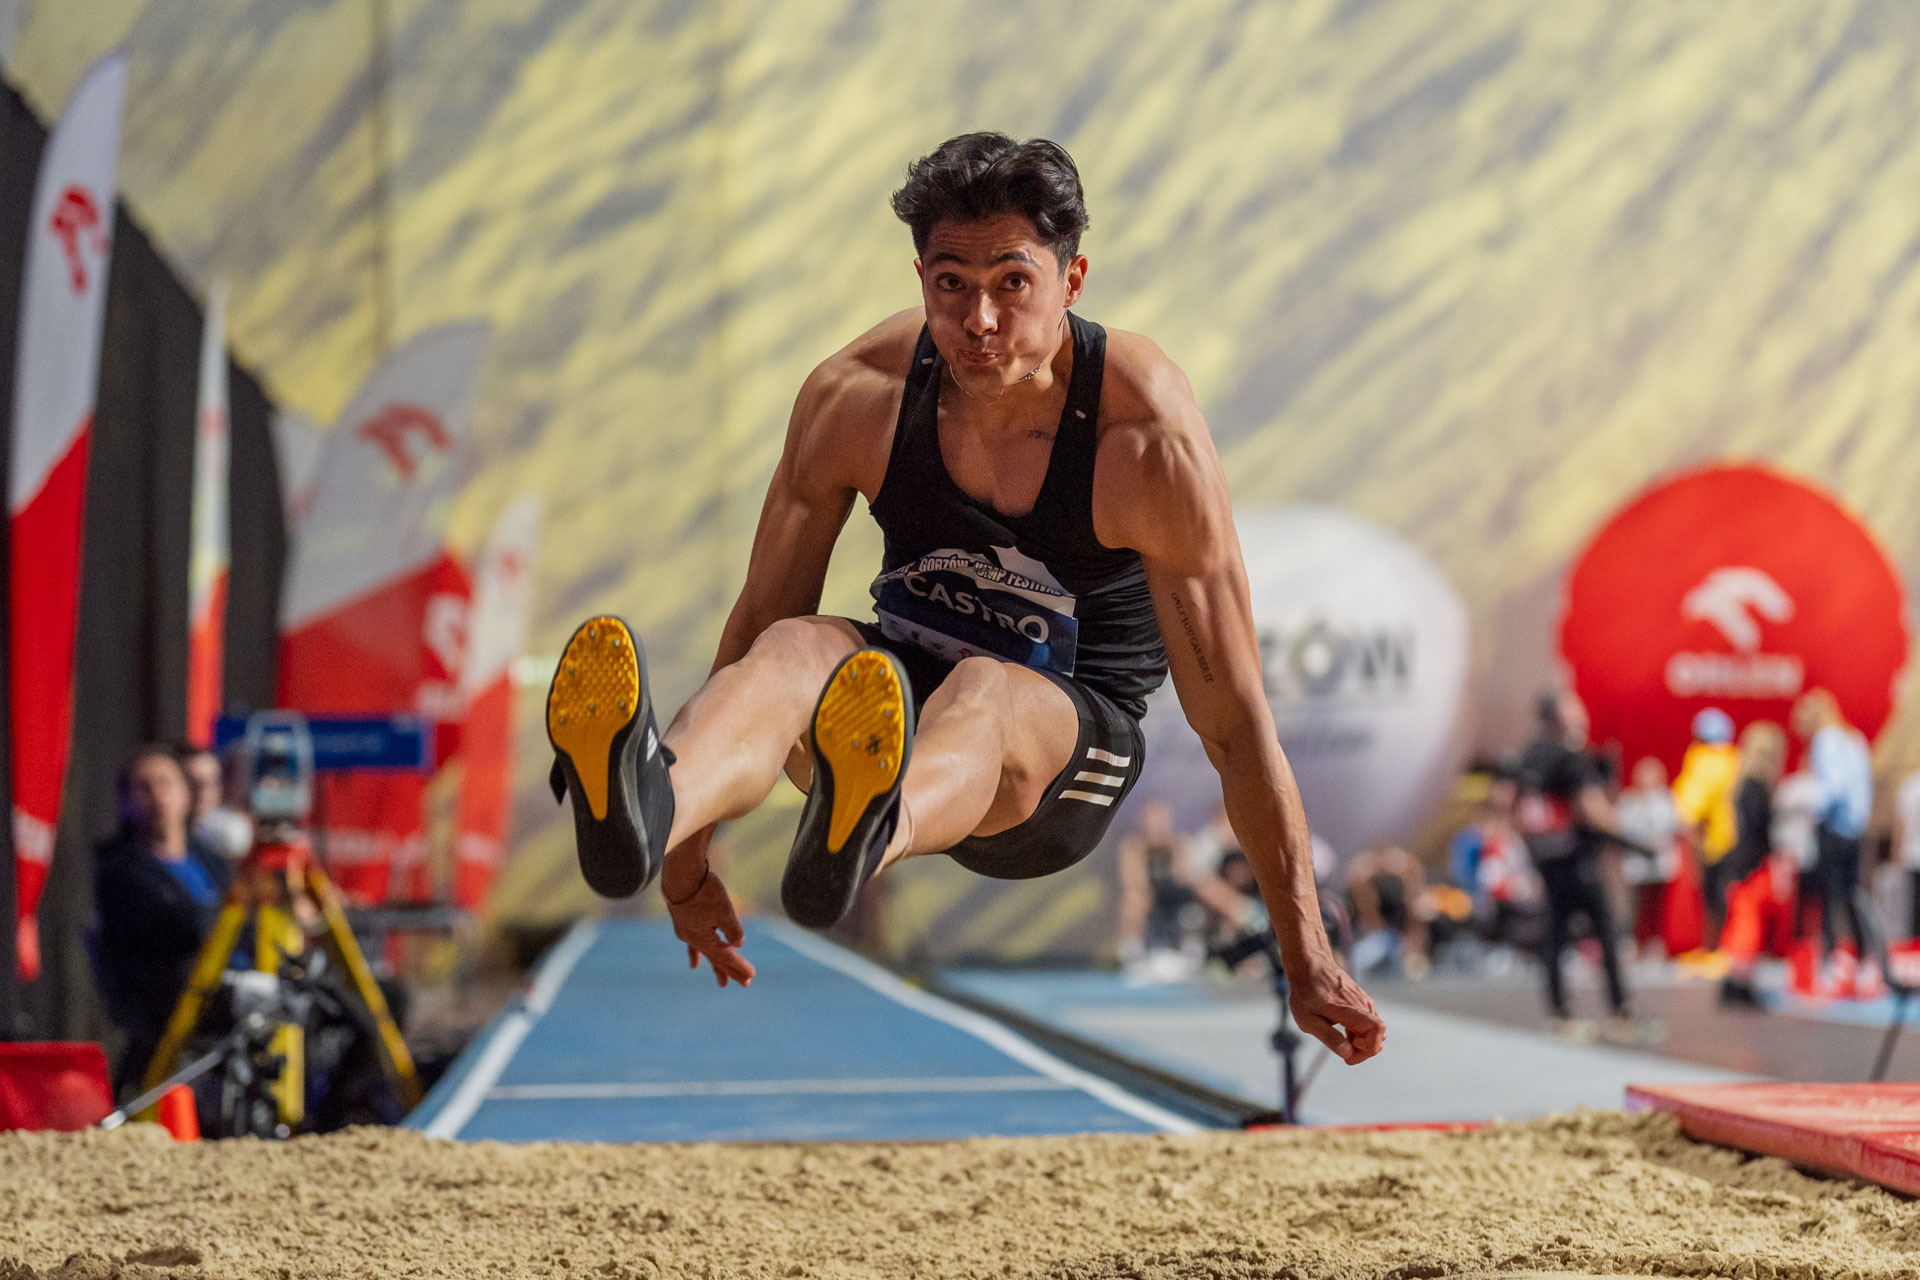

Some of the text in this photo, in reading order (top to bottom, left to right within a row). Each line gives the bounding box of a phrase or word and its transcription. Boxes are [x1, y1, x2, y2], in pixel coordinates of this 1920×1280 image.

[918, 555, 969, 572] GORZÓW
[904, 573, 1050, 644] CASTRO
[1171, 592, 1185, 615] ONLY
[1181, 617, 1195, 637] YOU
